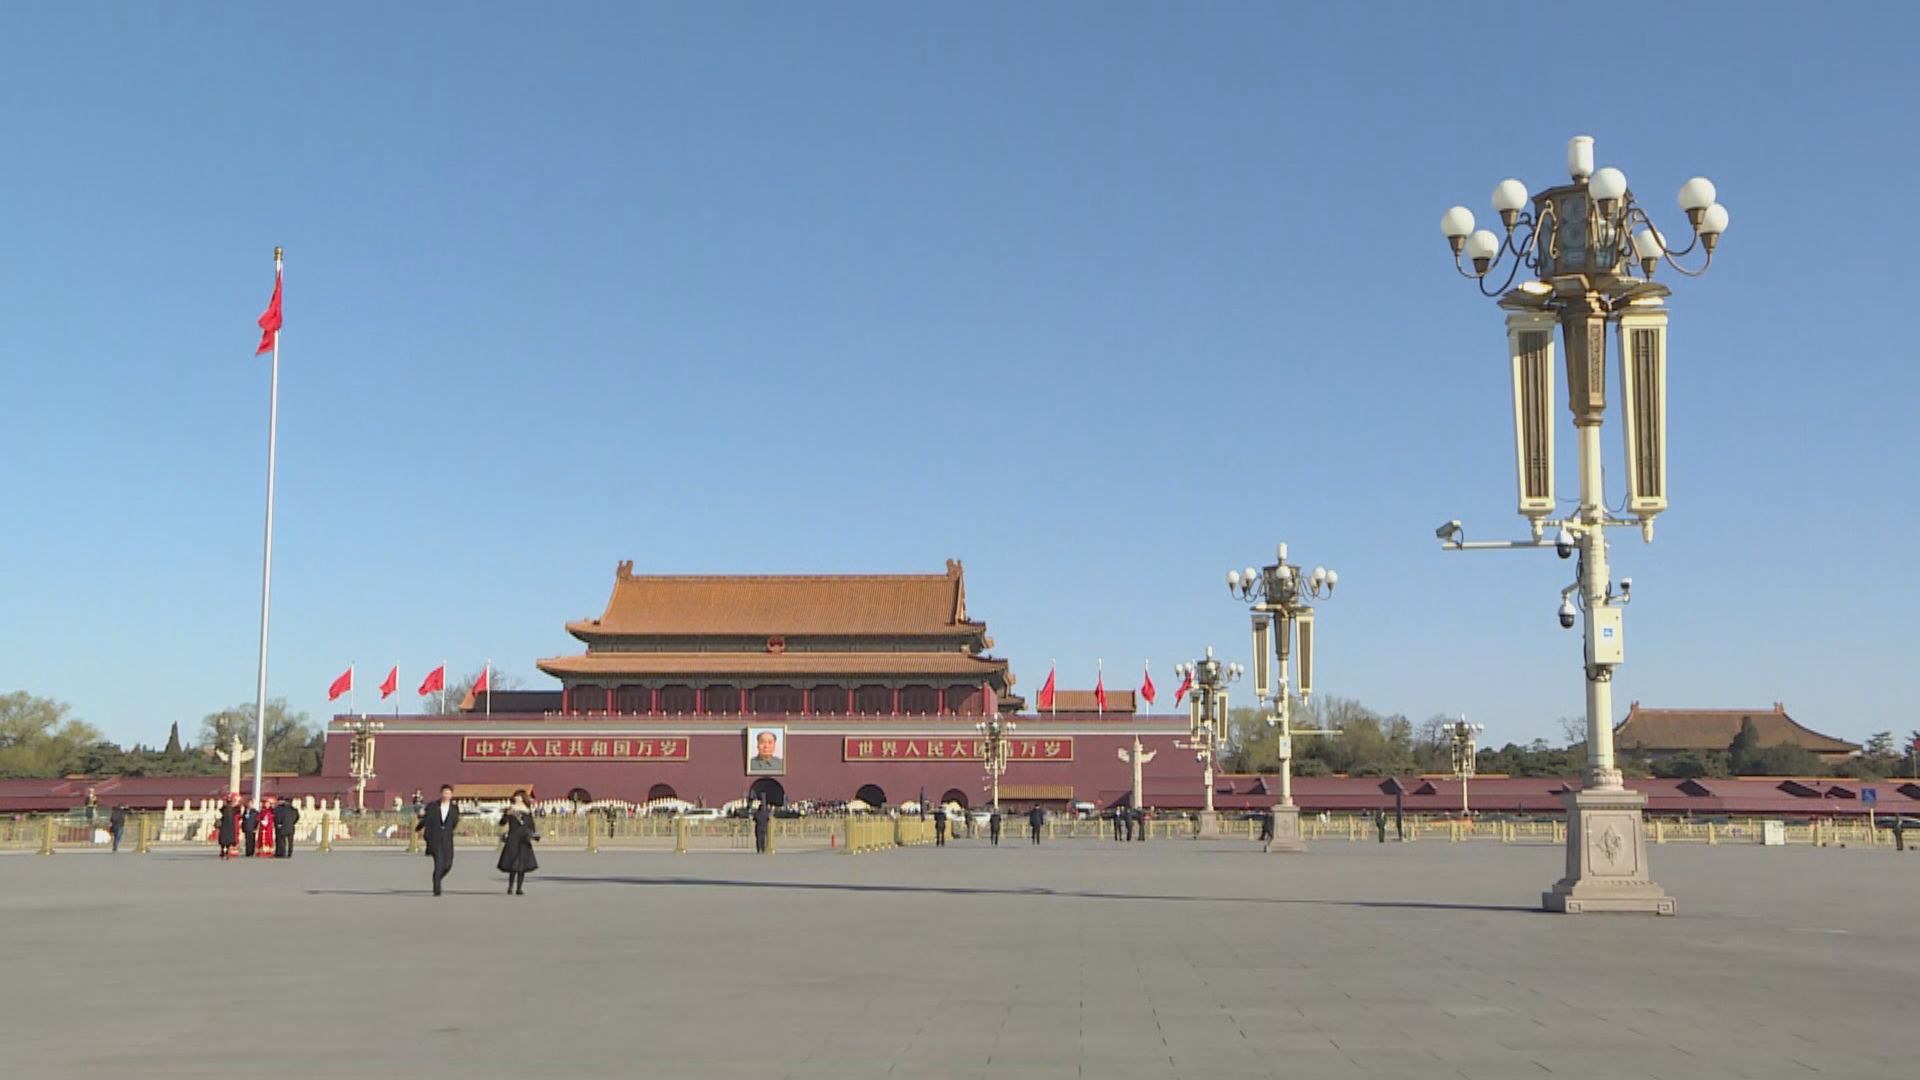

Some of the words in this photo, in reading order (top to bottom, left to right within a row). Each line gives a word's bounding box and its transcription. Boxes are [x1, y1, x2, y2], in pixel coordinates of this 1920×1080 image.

[475, 739, 677, 756] 中华人民共和国万岁
